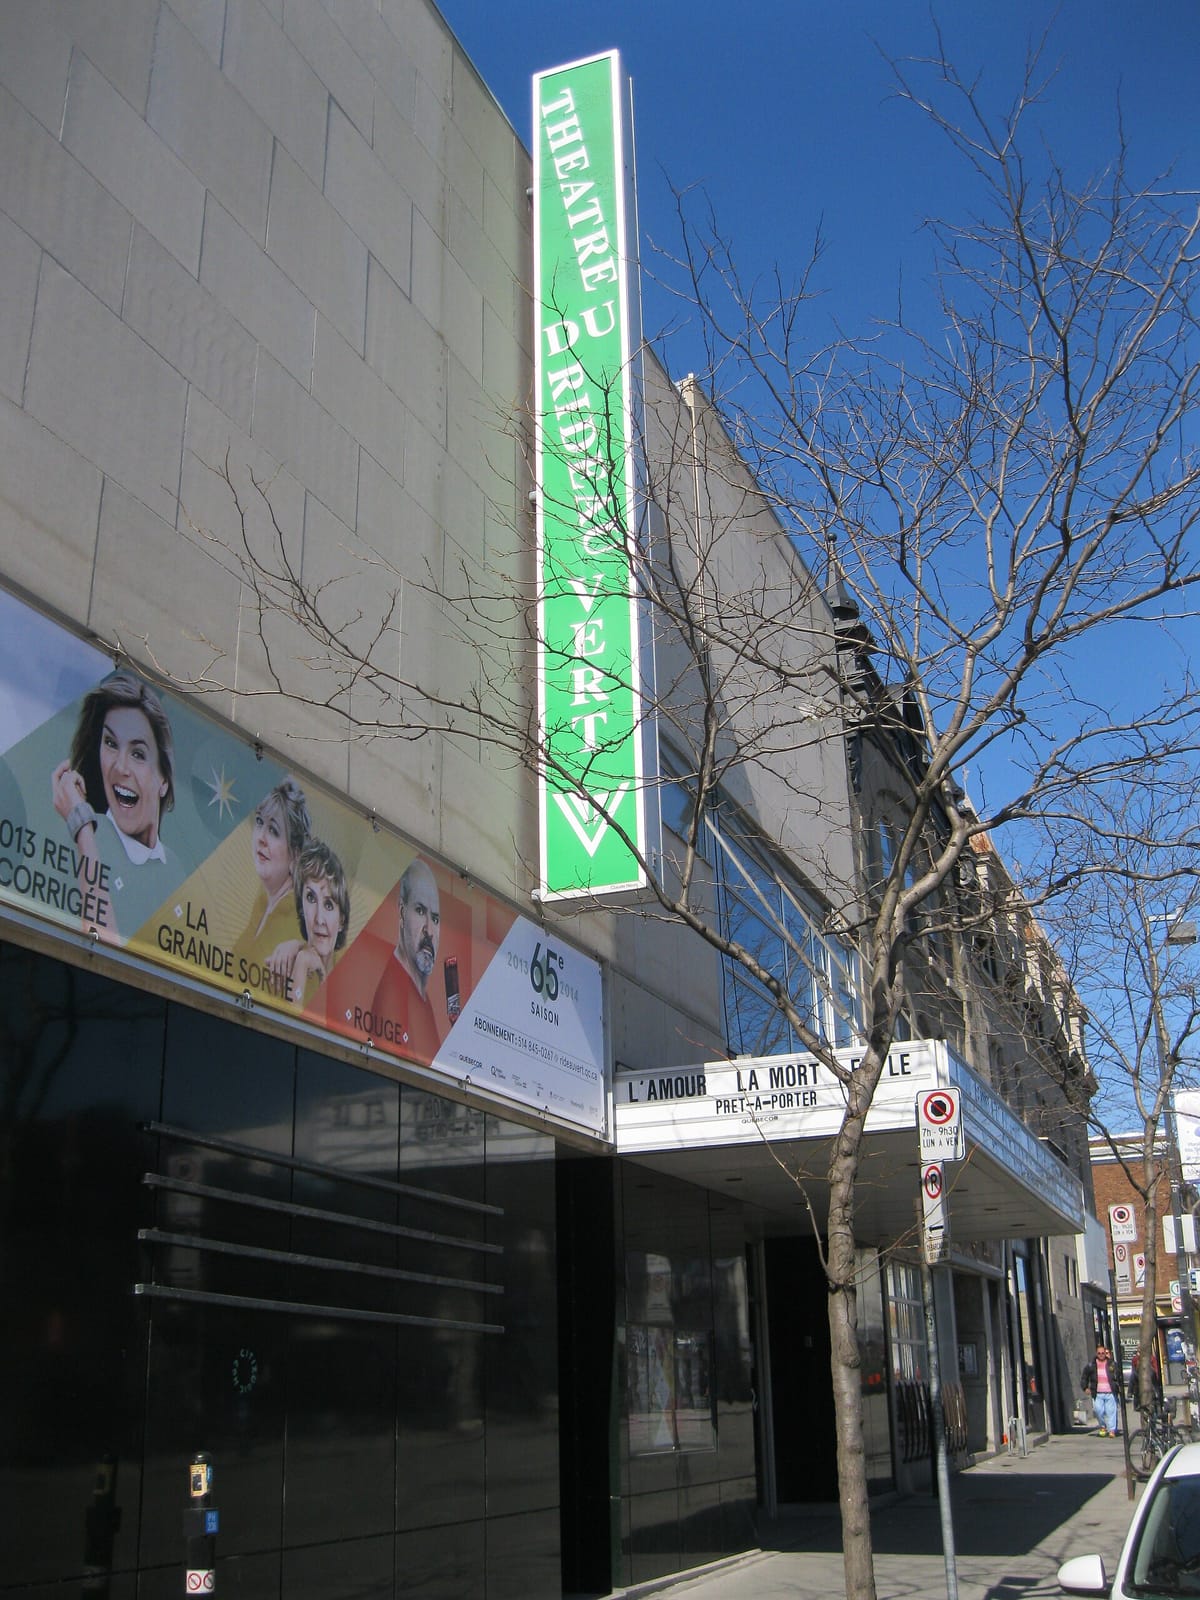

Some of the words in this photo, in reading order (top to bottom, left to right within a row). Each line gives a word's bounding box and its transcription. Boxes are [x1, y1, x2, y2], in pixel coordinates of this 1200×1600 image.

[542, 87, 617, 292] THEATRE
[543, 300, 616, 357] DU
[547, 363, 623, 556] RIDEAU
[568, 574, 610, 753] VERT
[43, 838, 111, 892] REVUE
[0, 857, 109, 927] CORRIGÉE
[186, 902, 209, 935] LA
[158, 924, 234, 978] GRANDE
[238, 958, 294, 1002] SORTIE
[507, 951, 529, 975] 2013
[560, 981, 579, 1003] 2014
[354, 1006, 402, 1045] ROUGE
[530, 1001, 559, 1026] SAISON
[628, 1075, 706, 1103] L'AMOUR
[737, 1069, 759, 1092] LA
[769, 1063, 820, 1089] MORT
[888, 1053, 911, 1077] LE
[716, 1091, 817, 1115] PRET-A-PORTER
[922, 1128, 932, 1137] 7h
[939, 1126, 958, 1136] 9h30
[922, 1139, 935, 1148] LUN
[946, 1136, 958, 1146] VEN
